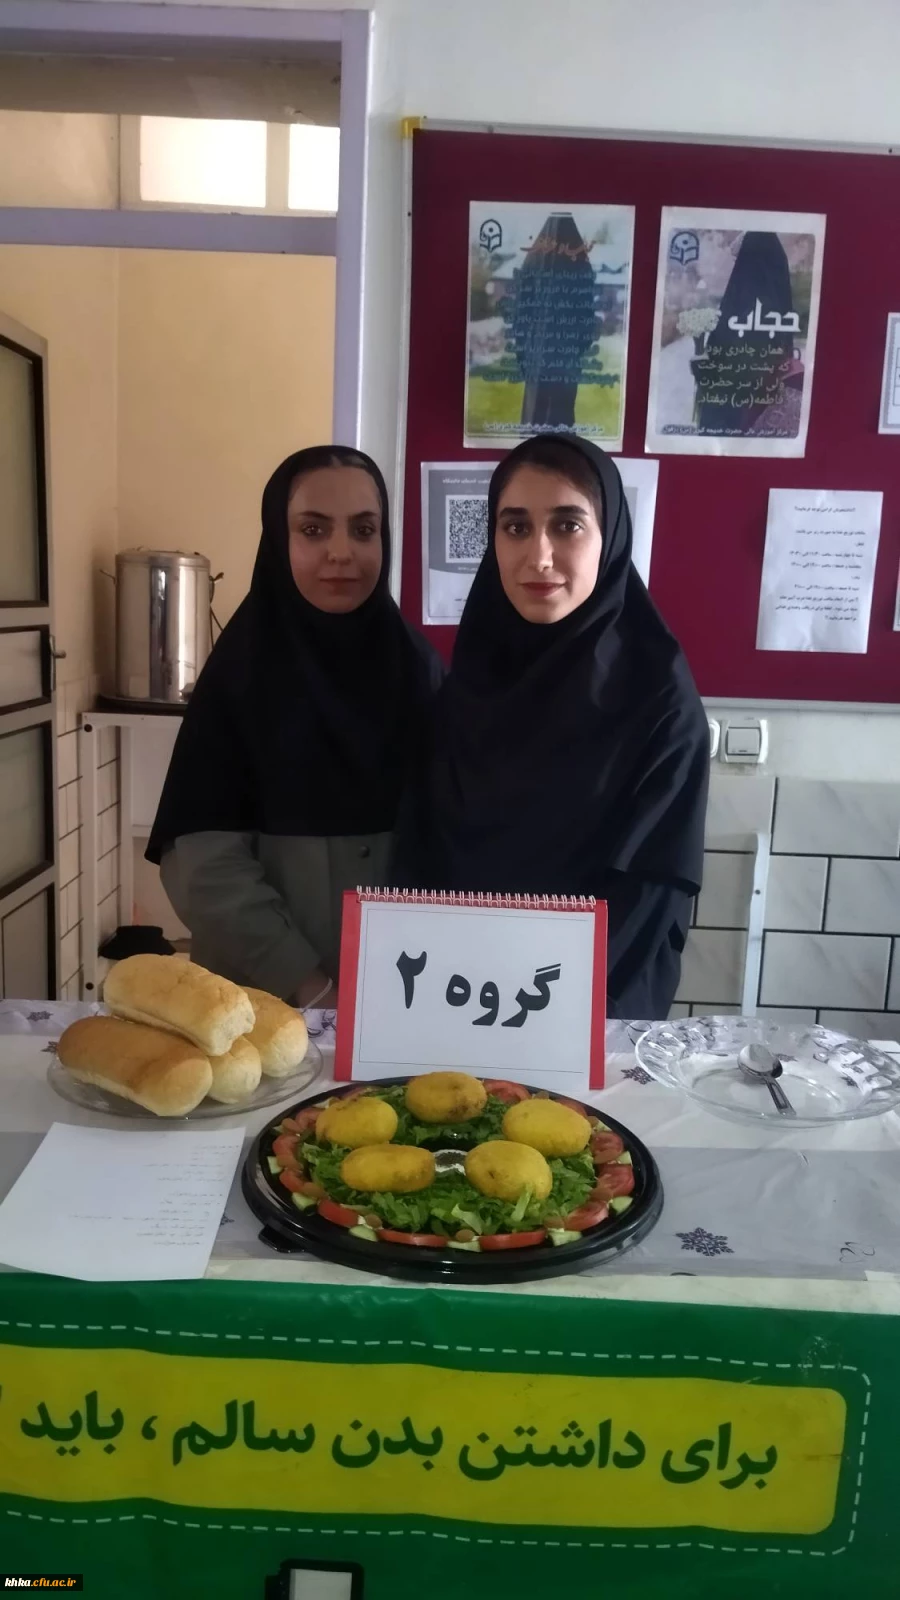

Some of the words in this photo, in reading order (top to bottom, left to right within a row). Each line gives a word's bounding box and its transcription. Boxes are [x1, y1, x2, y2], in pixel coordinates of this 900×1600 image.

[727, 296, 801, 339] حجاب
[707, 344, 723, 356] بود
[725, 341, 756, 357] چادری
[759, 343, 784, 358] همان
[697, 360, 733, 372] سوخت
[735, 363, 747, 373] در
[749, 361, 775, 374] پشت
[778, 361, 790, 372] که
[700, 376, 735, 389] حضرت
[735, 380, 752, 390] سر
[753, 376, 764, 391] از
[766, 377, 785, 392] ولی
[396, 951, 427, 1009] ۲
[446, 963, 561, 1028] گروه
[20, 1389, 125, 1456] باید
[171, 1398, 316, 1468] سالم
[330, 1415, 444, 1472] بدن
[458, 1417, 647, 1481] داشتن
[660, 1420, 779, 1490] برای
